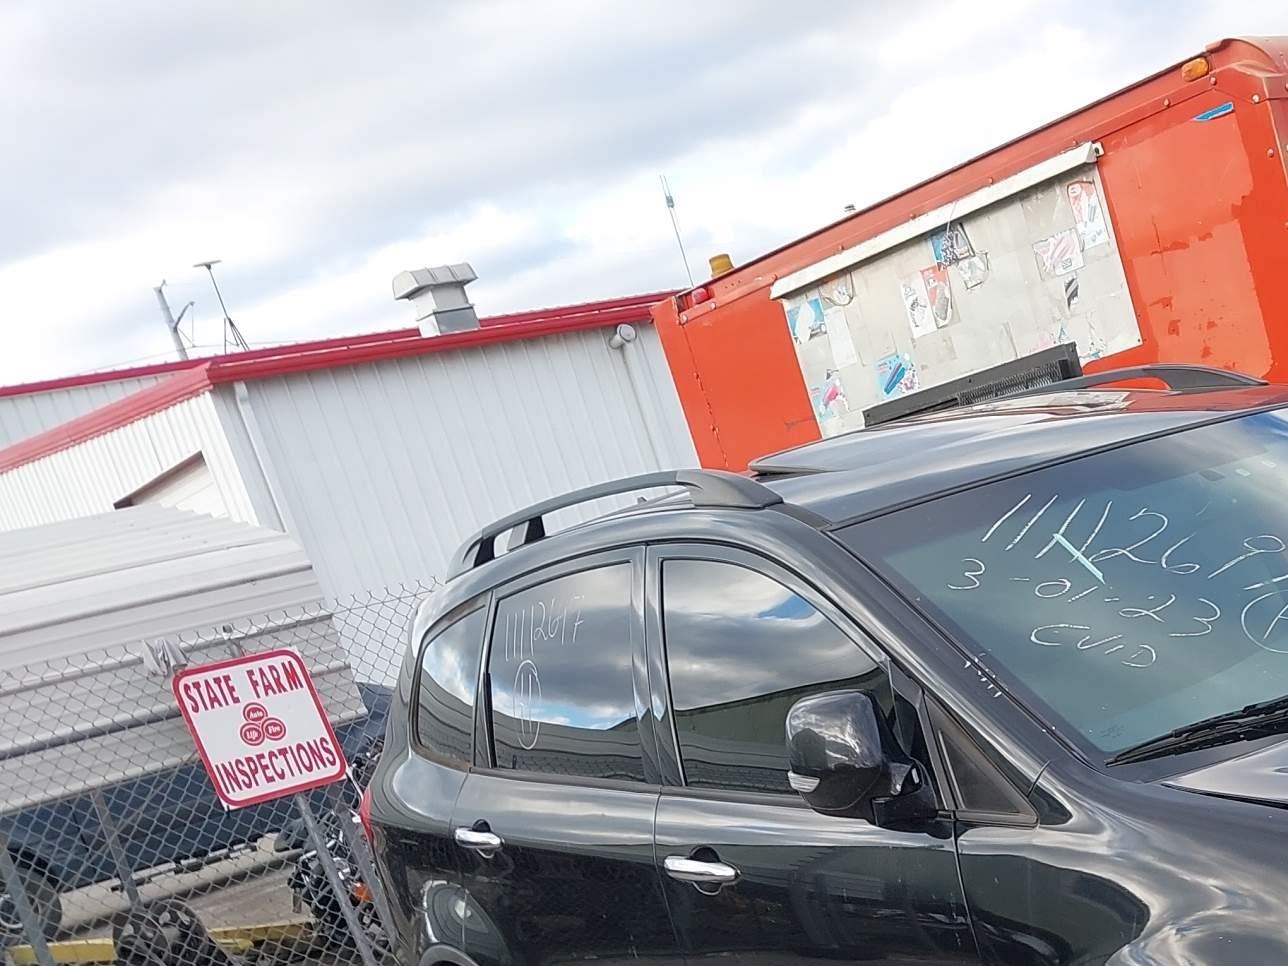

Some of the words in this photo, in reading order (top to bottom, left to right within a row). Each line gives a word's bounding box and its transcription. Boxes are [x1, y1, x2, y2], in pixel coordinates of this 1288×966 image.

[183, 674, 240, 713] STATE
[246, 660, 304, 698] FARM
[215, 737, 337, 794] INSPECTIONS
